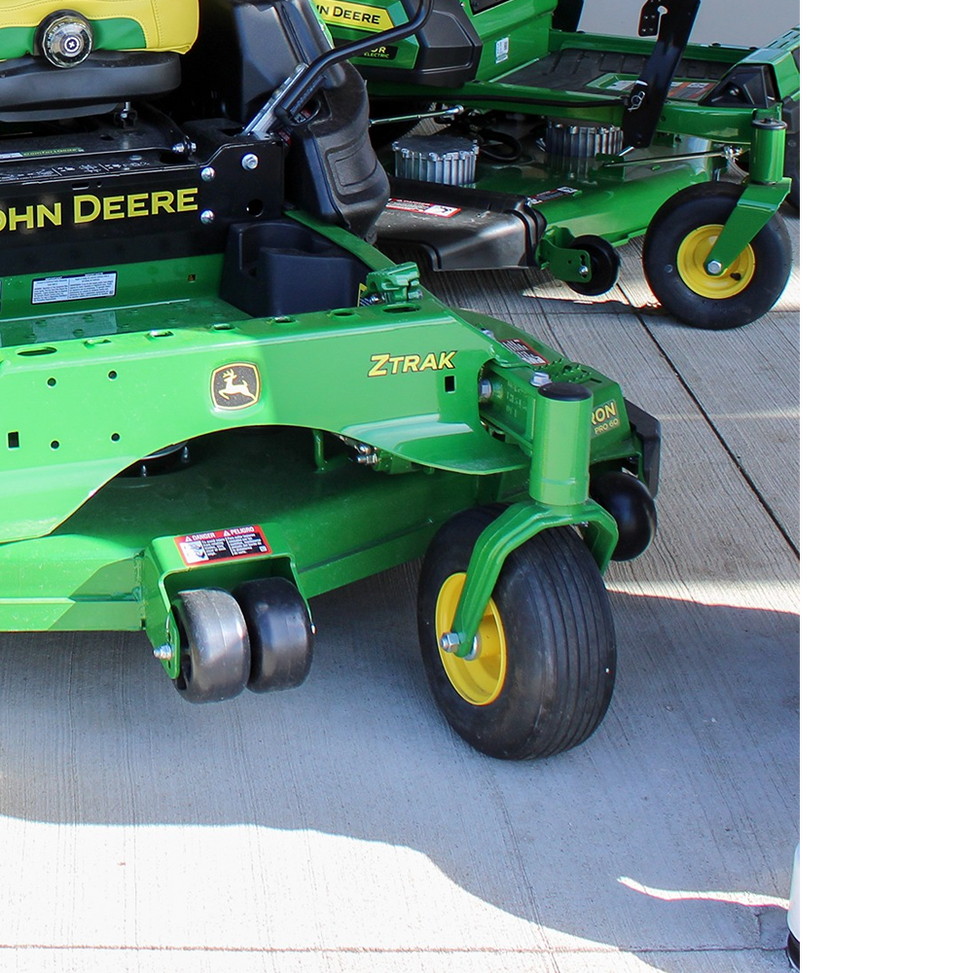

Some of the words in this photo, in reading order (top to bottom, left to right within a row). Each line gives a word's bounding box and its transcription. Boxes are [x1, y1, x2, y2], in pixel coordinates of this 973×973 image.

[333, 6, 381, 25] DEERE
[73, 187, 199, 224] DEERE
[367, 350, 458, 377] ZTRAK
[594, 423, 609, 435] PRO
[609, 418, 619, 428] 60
[191, 532, 216, 541] DANGER
[230, 526, 255, 535] PELIGRO
